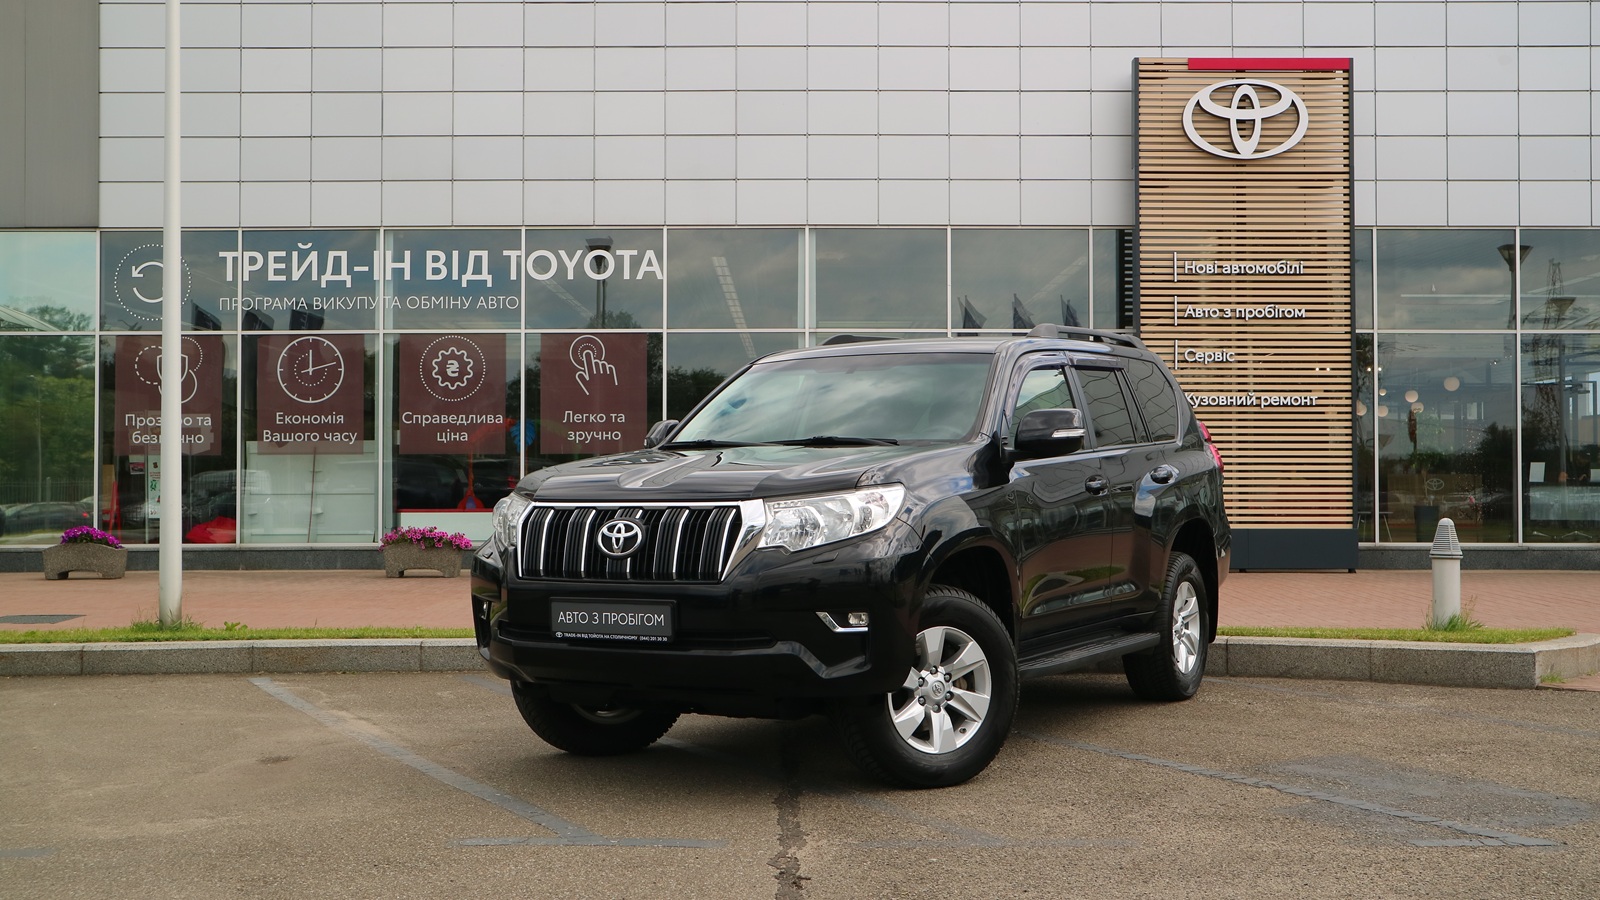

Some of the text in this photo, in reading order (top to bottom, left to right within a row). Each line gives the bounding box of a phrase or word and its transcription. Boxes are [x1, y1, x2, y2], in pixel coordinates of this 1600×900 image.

[426, 250, 492, 287] ВІД
[503, 250, 663, 280] TOYOTA
[1184, 261, 1304, 274] Нові автомобілі
[219, 297, 308, 310] ПРОГРАМА
[313, 297, 378, 310] ВИКУПУ
[406, 296, 472, 309] ОБМІНУ
[476, 296, 519, 309] АВТО
[1184, 304, 1306, 321] Авто з пробігом
[1184, 349, 1235, 364] Сервіс
[1185, 392, 1318, 408] Кузовний ремонт
[196, 416, 212, 426] та
[276, 412, 344, 424] Економія
[402, 411, 503, 426] Справедлива
[563, 411, 625, 423] Легко та
[263, 430, 358, 444] Вашого часу
[437, 430, 468, 442] ціна
[567, 431, 622, 443] зручно
[558, 611, 589, 624] АВТО
[602, 612, 665, 626] ПРОБІГОМ
